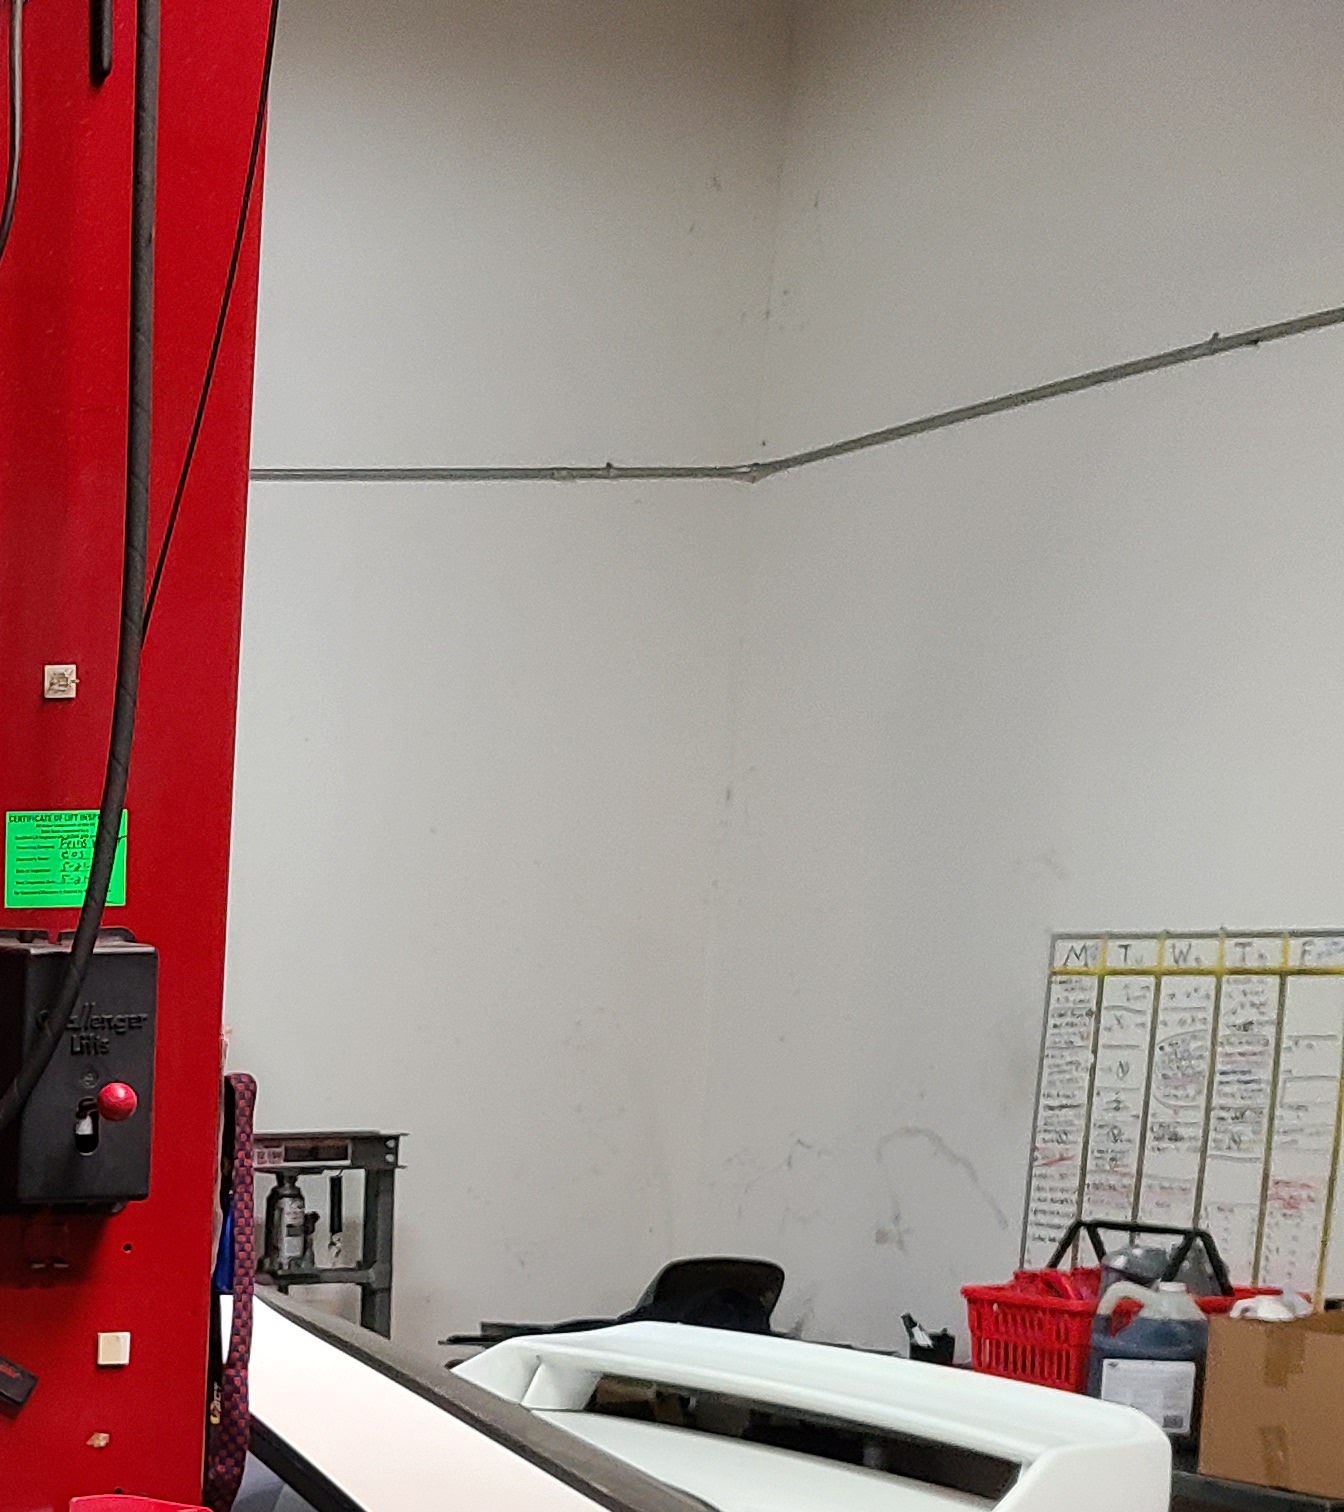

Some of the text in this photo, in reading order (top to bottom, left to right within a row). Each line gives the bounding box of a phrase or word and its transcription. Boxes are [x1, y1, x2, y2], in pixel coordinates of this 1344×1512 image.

[9, 814, 52, 823] CERTIFICATE
[64, 813, 78, 822] LIFT
[36, 1002, 148, 1035] Callenger
[71, 1033, 111, 1056] Lifts
